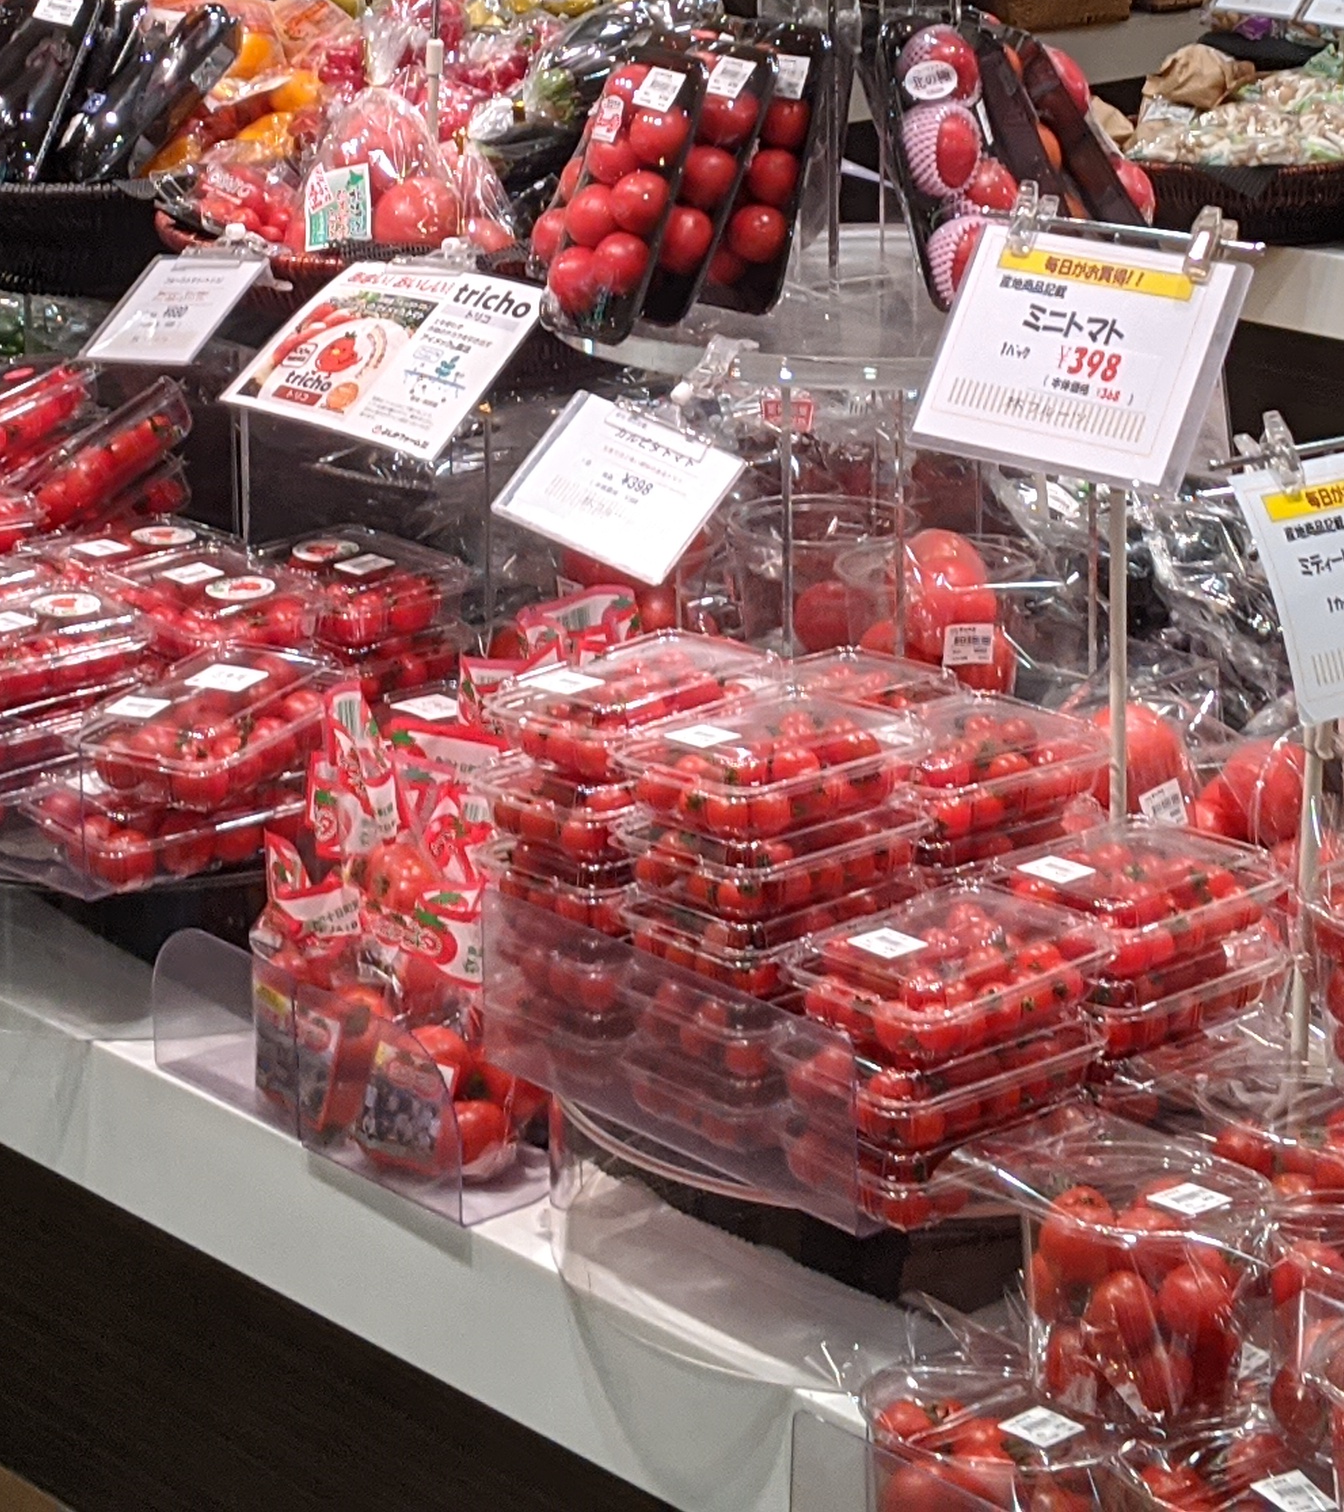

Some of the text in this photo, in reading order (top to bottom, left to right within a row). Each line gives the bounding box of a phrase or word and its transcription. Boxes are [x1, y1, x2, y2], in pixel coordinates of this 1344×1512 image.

[454, 283, 531, 320] tricho
[463, 310, 492, 325] トリコ
[1022, 302, 1124, 346] ミニトマト
[1000, 341, 1122, 383] 1パック ¥398
[284, 371, 333, 393] tricho
[621, 472, 654, 496] ¥398
